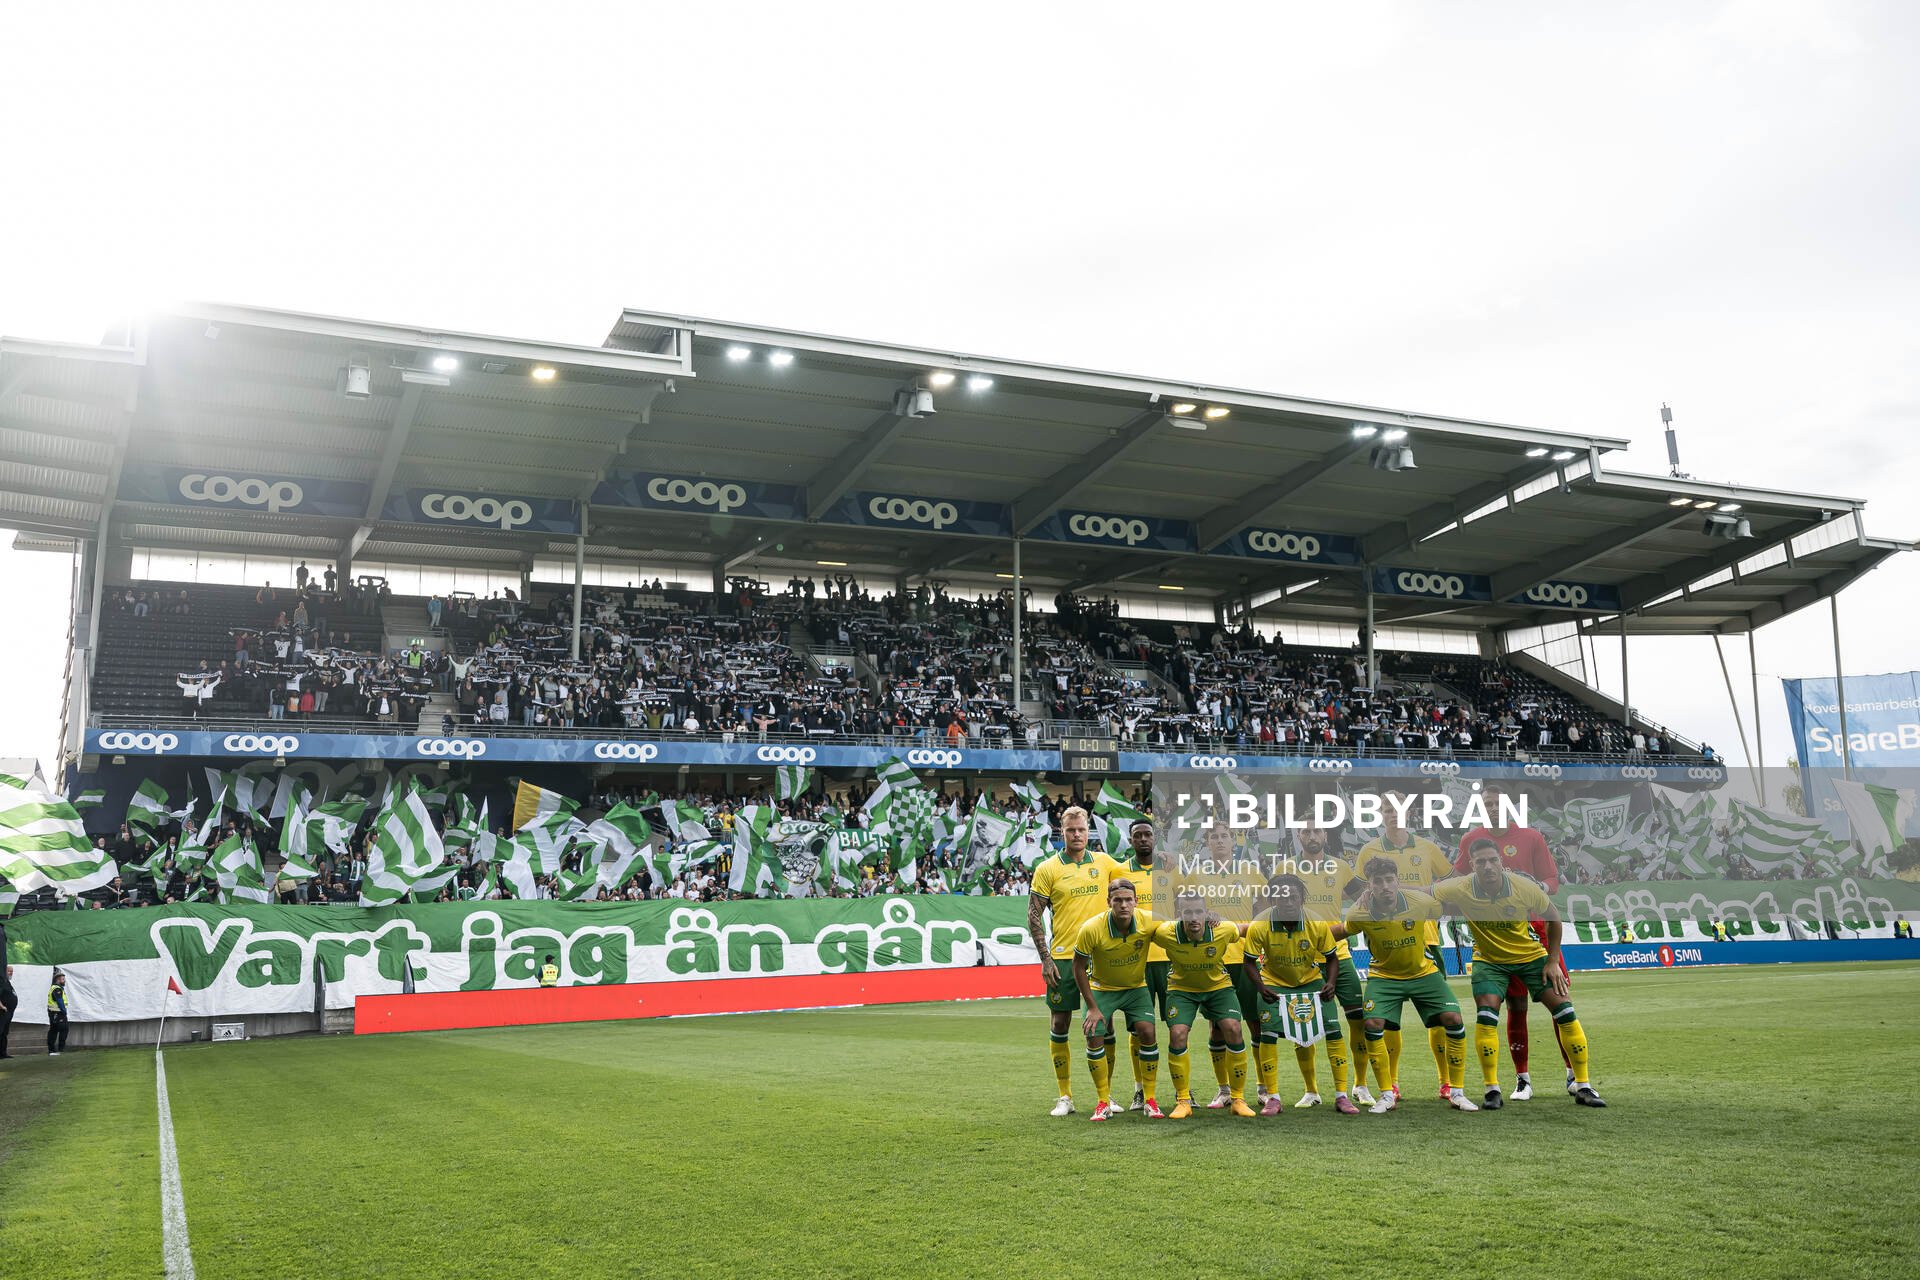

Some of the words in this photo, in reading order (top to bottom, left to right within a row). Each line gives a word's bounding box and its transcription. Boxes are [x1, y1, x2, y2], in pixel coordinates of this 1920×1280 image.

[179, 474, 303, 512] coop
[647, 476, 747, 513] coop
[420, 493, 533, 530] coop
[869, 497, 958, 529] coop
[1069, 514, 1149, 545] coop
[1248, 530, 1321, 560] coop
[1397, 571, 1464, 599] coop
[1526, 581, 1588, 608] coop
[98, 732, 179, 754] coop
[223, 735, 299, 756] coop
[416, 738, 487, 760] coop
[594, 742, 658, 763] coop
[1079, 739, 1099, 752] 0-0
[757, 745, 817, 766] coop
[907, 748, 963, 769] coop
[1080, 757, 1108, 770] 0:00
[1190, 756, 1237, 776] coop
[1309, 759, 1353, 777] coop
[1420, 761, 1461, 777] coop
[1523, 764, 1563, 780] coop
[1621, 766, 1658, 783] coop
[1687, 767, 1723, 783] coop
[1567, 888, 1782, 942] hjärtat
[152, 918, 431, 991] Vart
[460, 911, 634, 989] jag
[664, 908, 788, 973] än
[814, 900, 976, 974] går
[1603, 950, 1658, 967] SpareBank
[1674, 948, 1702, 962] SMN
